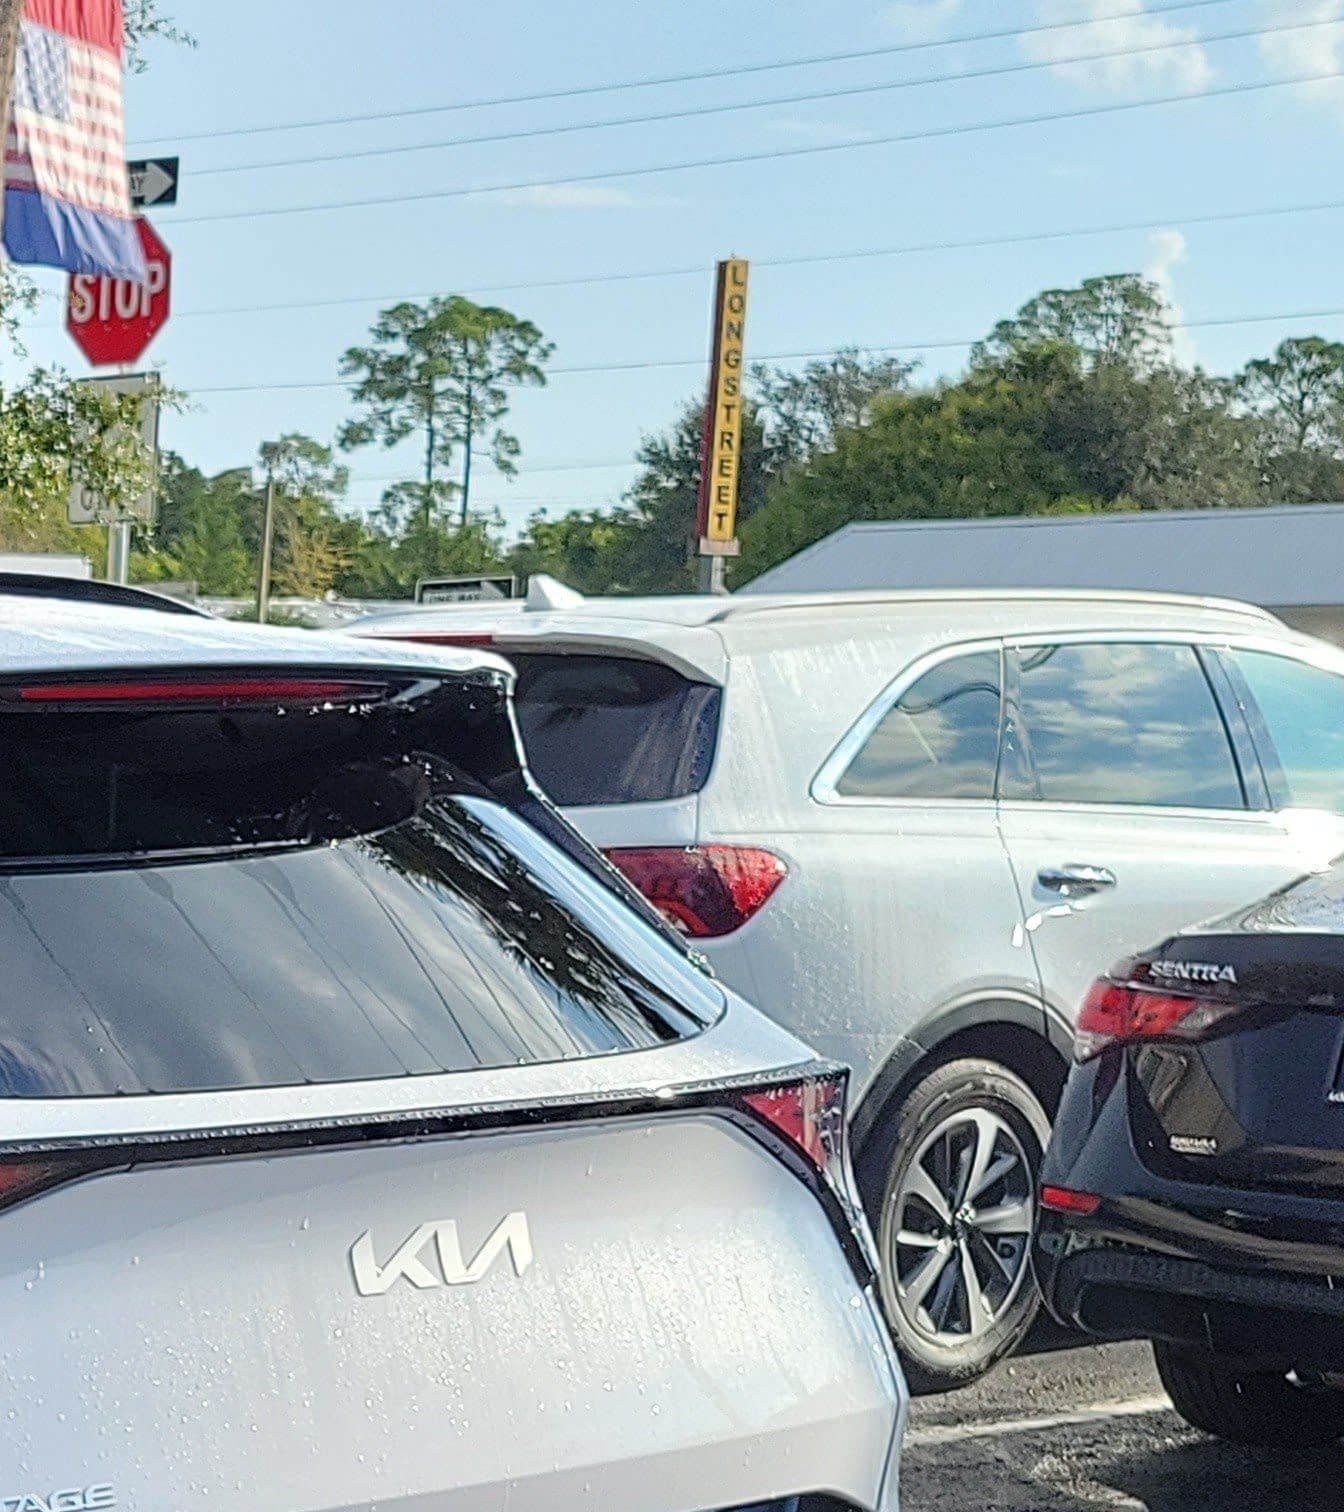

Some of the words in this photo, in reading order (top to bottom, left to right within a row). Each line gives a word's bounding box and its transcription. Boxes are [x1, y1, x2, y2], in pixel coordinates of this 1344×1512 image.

[71, 261, 166, 323] STOP
[714, 264, 745, 532] LONGSTREET
[1148, 960, 1237, 984] SENTRA
[348, 1210, 534, 1297] KIA
